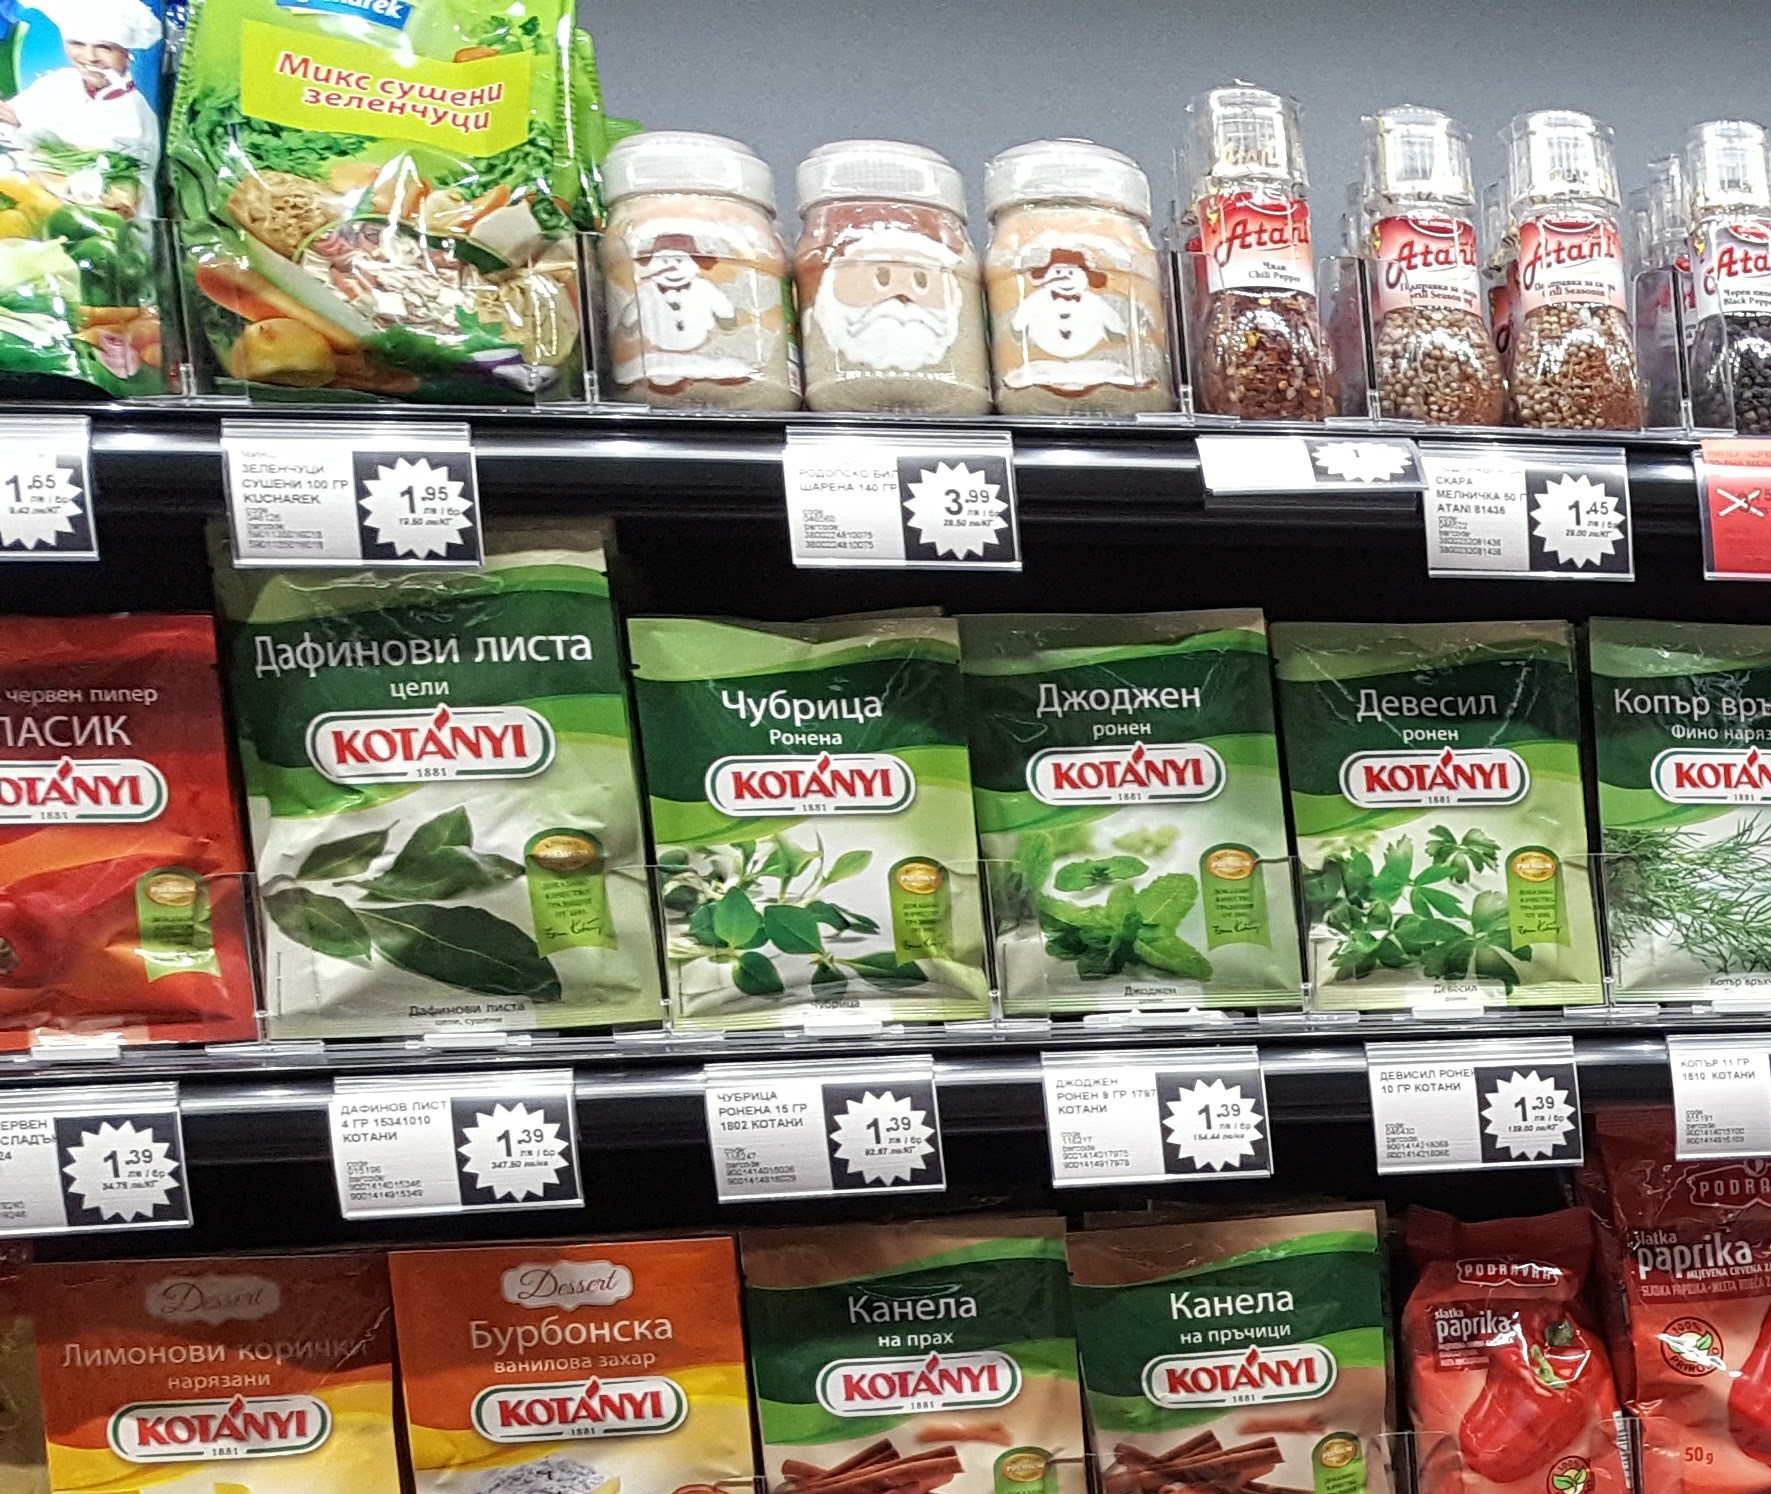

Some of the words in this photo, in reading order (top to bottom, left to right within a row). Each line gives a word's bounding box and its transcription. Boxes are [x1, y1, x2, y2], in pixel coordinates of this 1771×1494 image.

[278, 53, 371, 95] Микс
[380, 76, 503, 109] сушени
[304, 84, 490, 134] зеленчуци
[241, 462, 324, 474] ЗЕЛЕНЧУЦИ
[401, 485, 449, 515] 1.95
[256, 633, 458, 680] Дафинови
[475, 632, 593, 663] листа
[7, 687, 82, 702] червен
[89, 686, 158, 706] пипер
[391, 677, 450, 699] цели
[1038, 683, 1200, 717] Джоджен
[721, 689, 883, 727] Чубрица
[1357, 689, 1496, 721] Девесил
[1615, 690, 1711, 723] Копър
[770, 729, 842, 747] Ронена
[1093, 721, 1151, 740] ронен
[1672, 725, 1719, 743] Фино
[417, 767, 447, 778] 1881
[1056, 1077, 1119, 1088] ДЖОДЖЕН
[718, 1104, 774, 1116] РОНЕНА
[752, 1117, 803, 1128] КОТАНИ
[1197, 1104, 1241, 1130] 1.39
[1637, 1236, 1751, 1279] paprika
[849, 1296, 977, 1324] Канела
[1170, 1290, 1294, 1320] Канела
[471, 1317, 673, 1354] Бурбонска
[879, 1333, 900, 1348] на
[908, 1329, 954, 1351] прах
[1180, 1330, 1201, 1343] на
[1207, 1322, 1291, 1346] пръчици
[63, 1344, 226, 1370] Лимонови
[168, 1371, 271, 1390] нарязани
